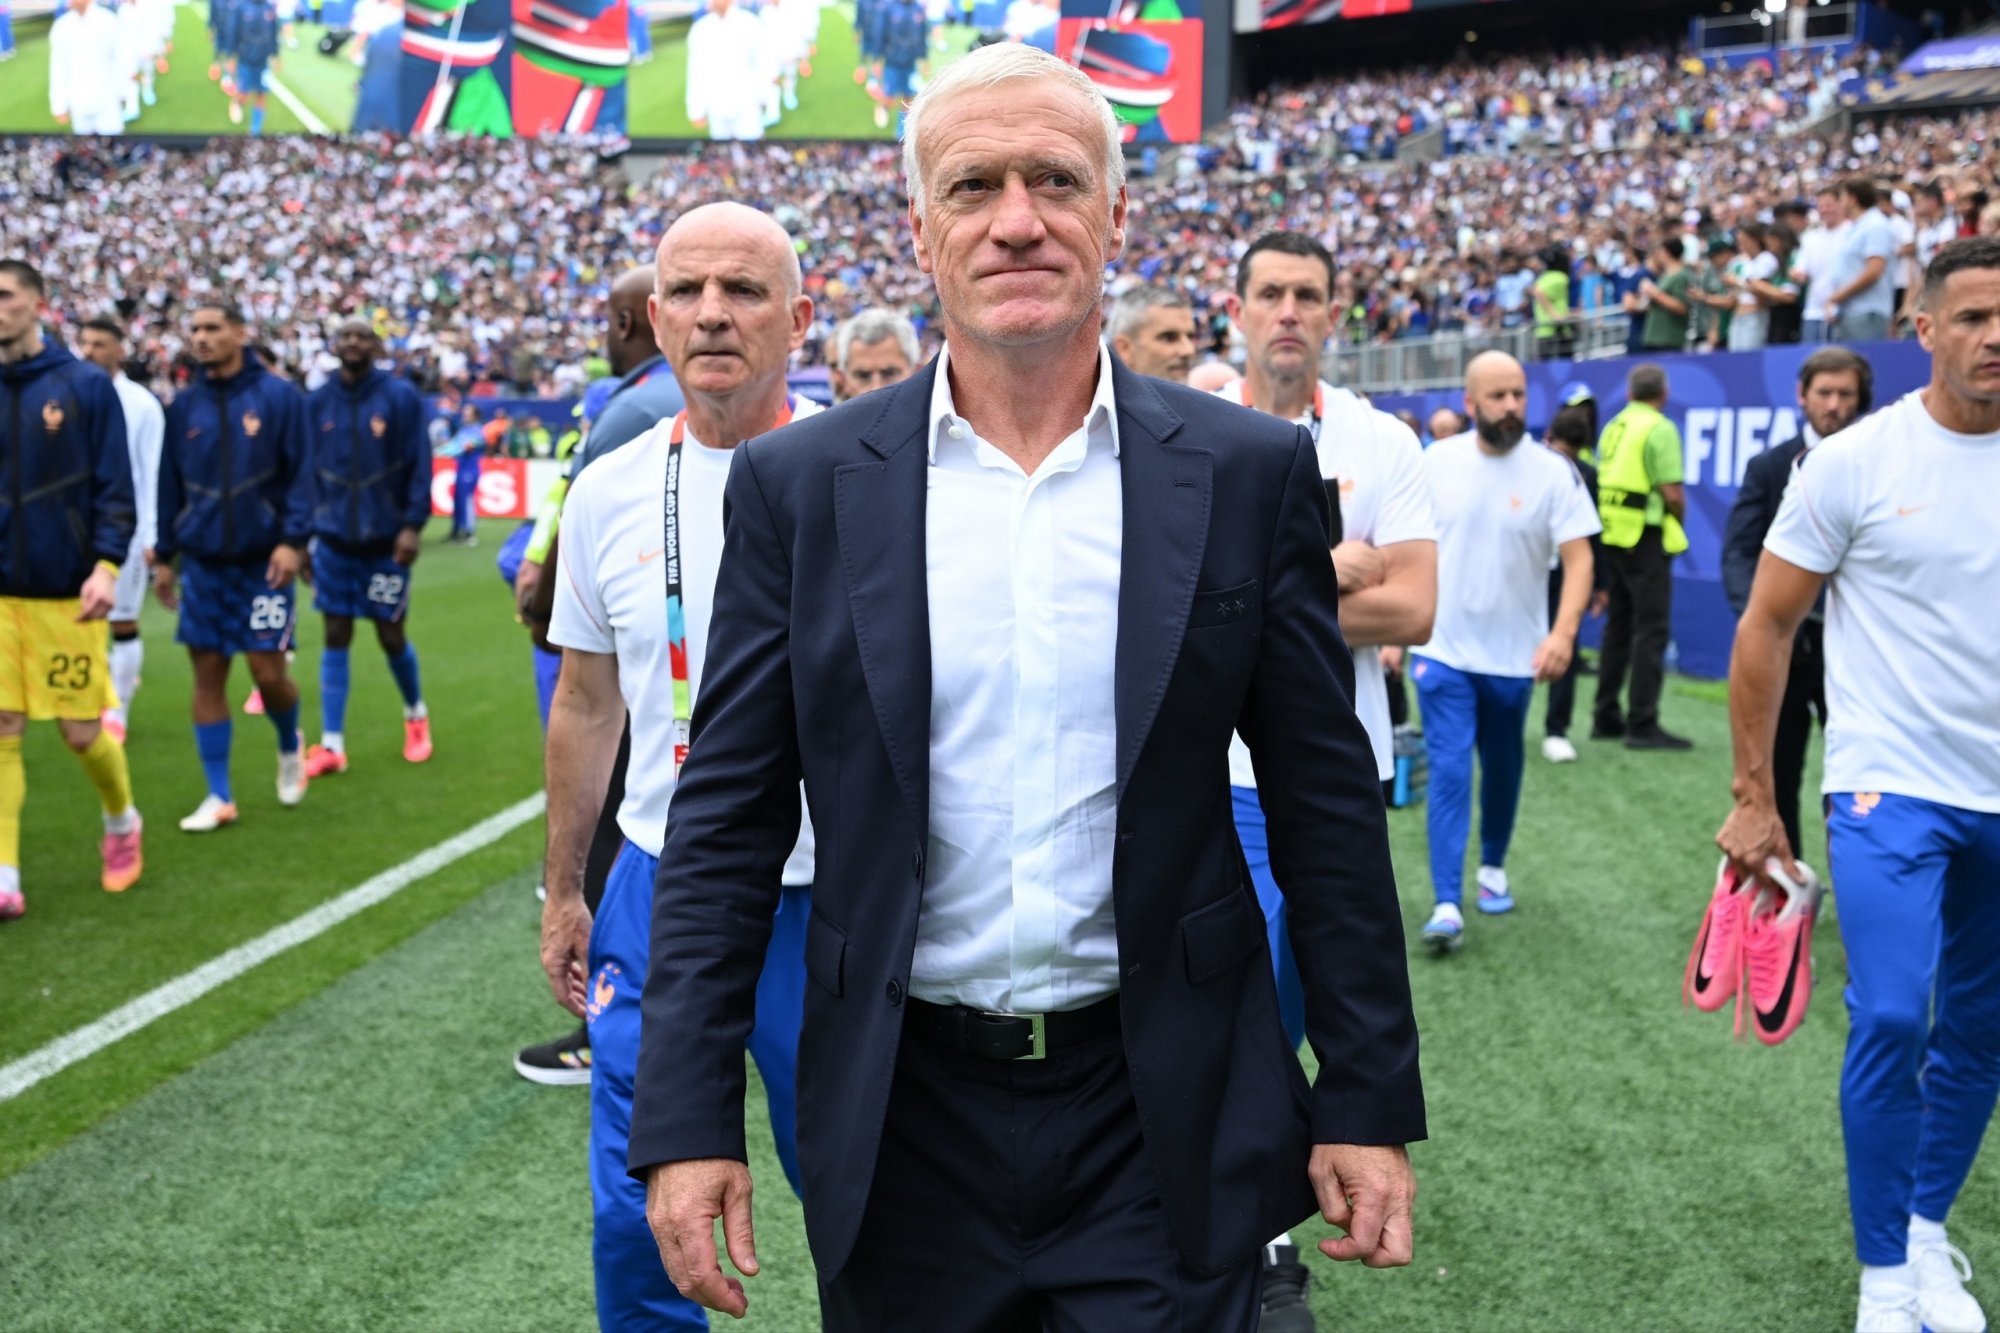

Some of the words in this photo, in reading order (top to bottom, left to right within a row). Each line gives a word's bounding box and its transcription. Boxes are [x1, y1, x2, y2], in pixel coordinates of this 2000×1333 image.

[666, 452, 679, 492] 2026
[666, 492, 676, 515] CUP
[666, 515, 677, 558] WORLD
[367, 573, 403, 604] 22
[667, 558, 679, 584] FIFA
[249, 595, 287, 630] 26
[47, 653, 91, 690] 23
